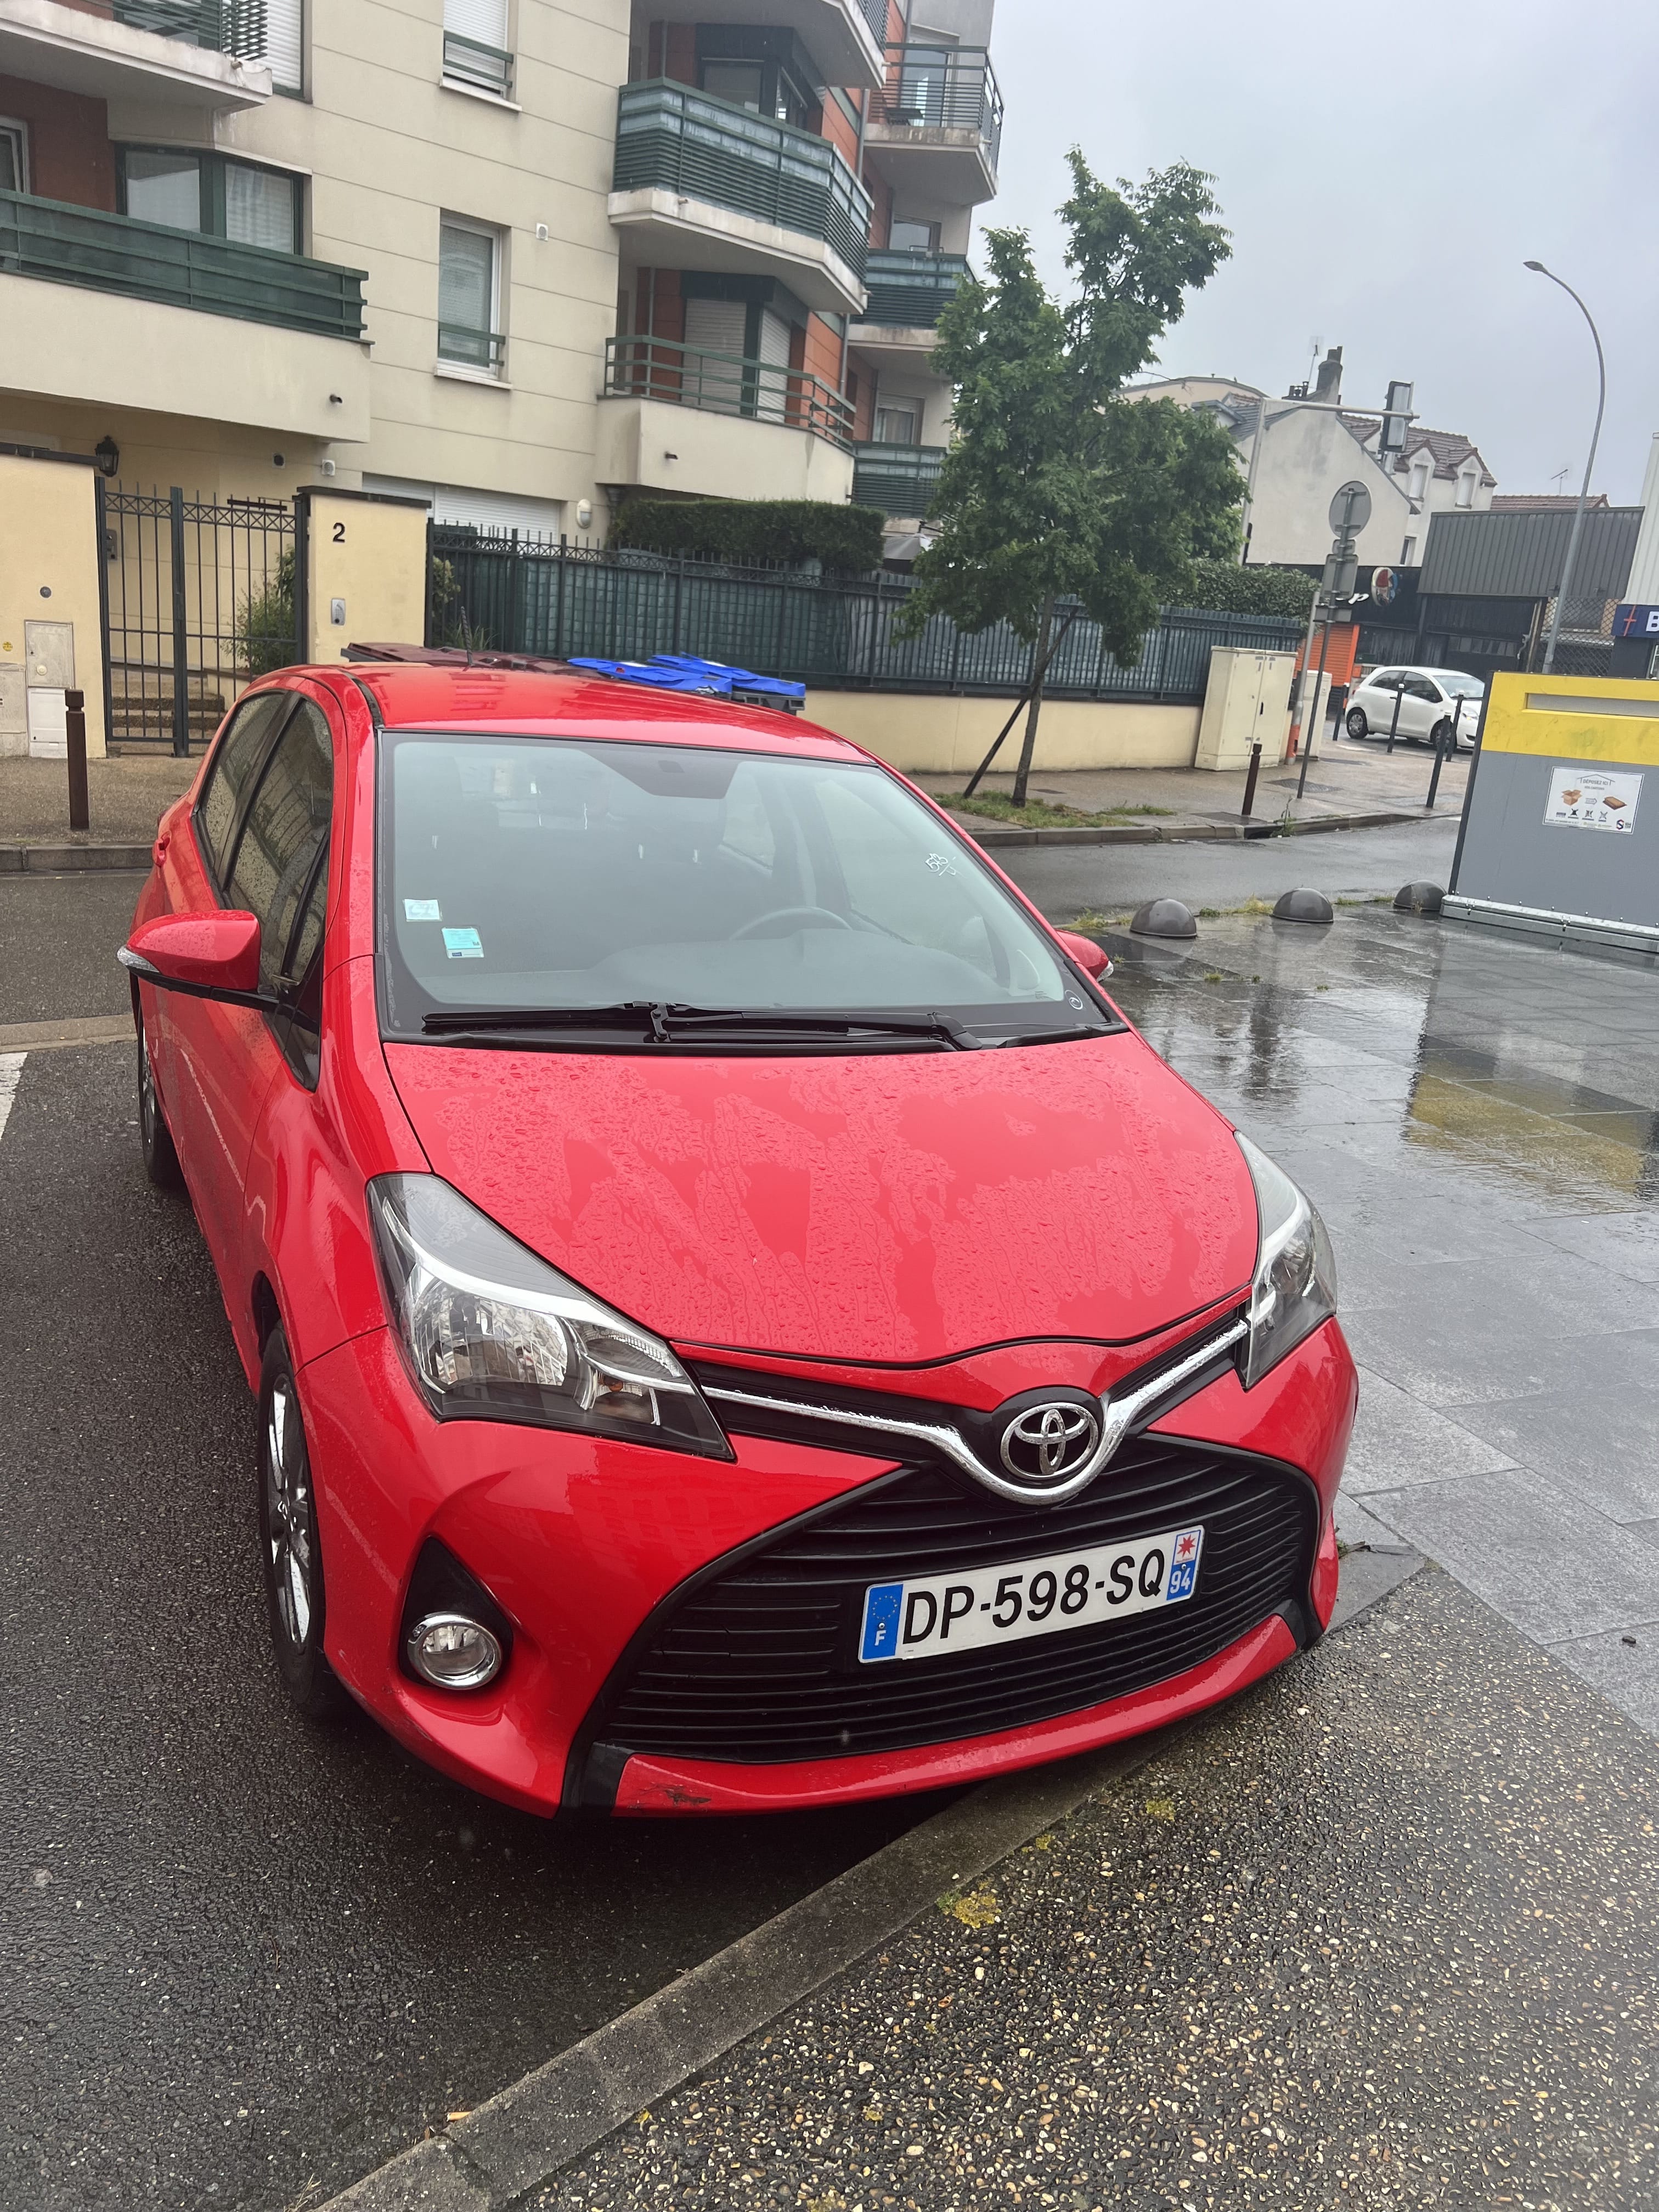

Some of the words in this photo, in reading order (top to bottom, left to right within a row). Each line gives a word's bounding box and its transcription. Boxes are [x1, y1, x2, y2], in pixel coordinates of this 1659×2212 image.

[333, 522, 345, 543] 2
[1170, 1567, 1191, 1594] 94
[902, 1549, 1165, 1644] DP-598-SQ
[874, 1630, 887, 1646] F
